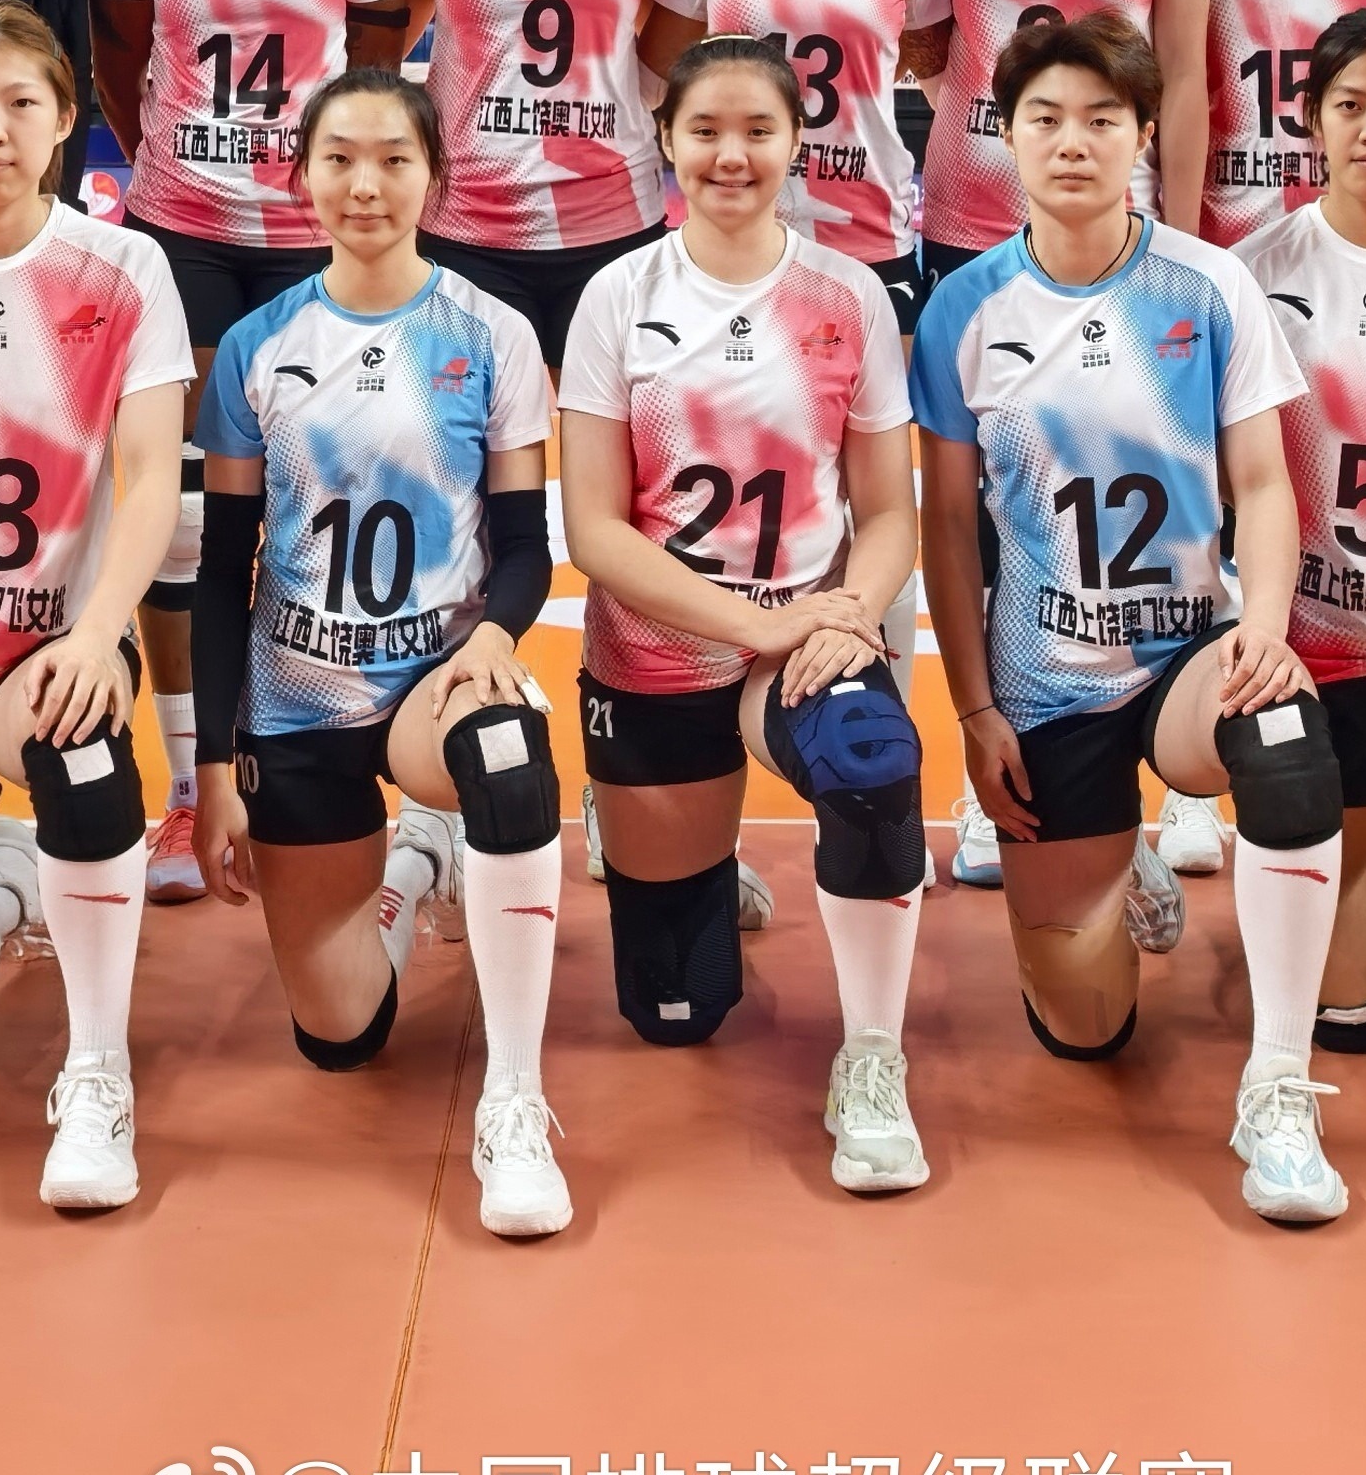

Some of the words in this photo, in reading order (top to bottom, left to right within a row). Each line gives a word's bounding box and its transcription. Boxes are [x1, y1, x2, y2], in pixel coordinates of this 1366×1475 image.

[197, 33, 291, 121] 14
[1240, 48, 1313, 139] 15
[476, 95, 616, 139] 江西上饶奥飞女排
[312, 499, 415, 617] 10
[664, 464, 787, 580] 21
[1053, 473, 1172, 591] 12
[271, 597, 444, 666] 江西上饶奥飞女排
[1038, 585, 1214, 648] 江西上饶奥飞女排
[588, 697, 614, 738] 21
[237, 752, 260, 794] 10
